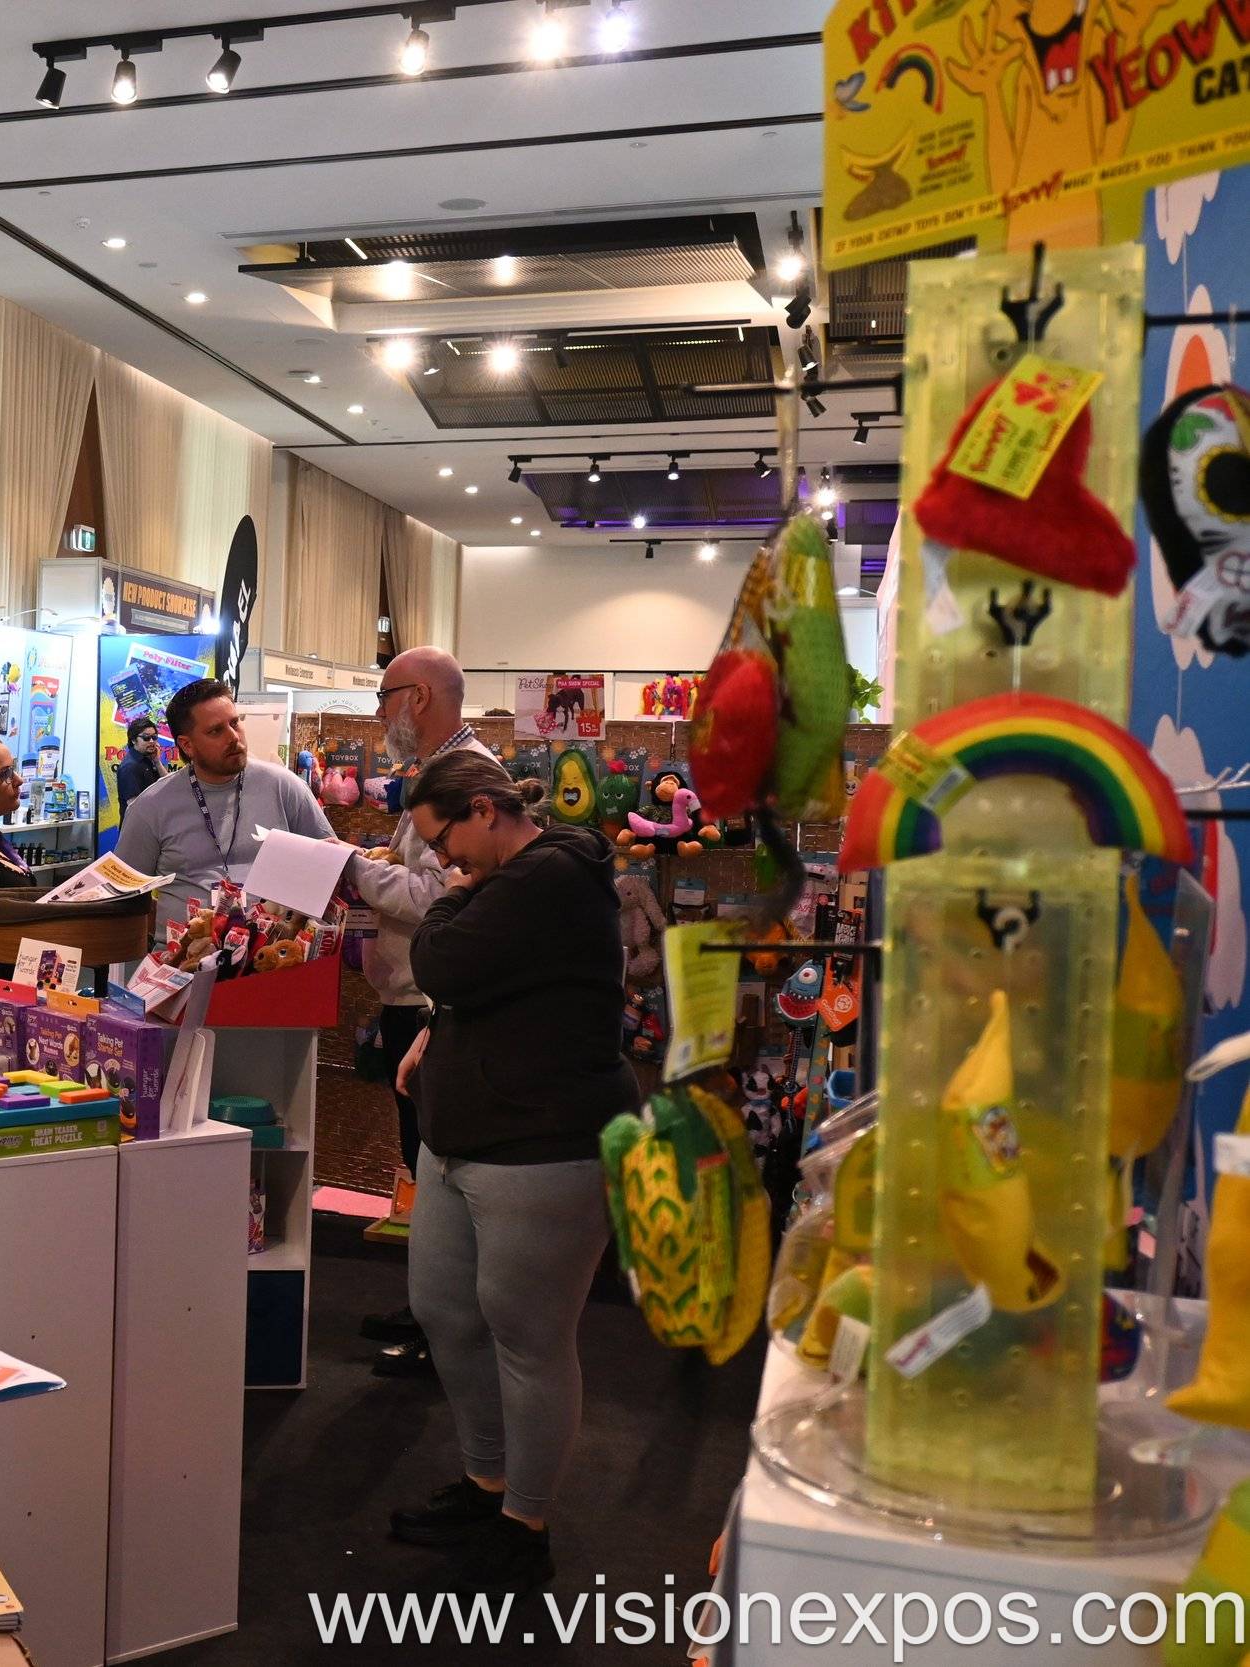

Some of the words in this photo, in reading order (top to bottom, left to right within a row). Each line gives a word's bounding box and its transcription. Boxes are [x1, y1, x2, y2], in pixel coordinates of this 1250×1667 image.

[847, 0, 920, 64] KI
[123, 581, 137, 604] NEW
[138, 586, 166, 610] PRODUCT
[166, 592, 197, 618] SHOWCASE
[97, 1032, 114, 1046] Talking
[115, 1037, 124, 1048] Pet
[30, 1136, 53, 1147] TREAT
[55, 1132, 83, 1144] PUZZLE
